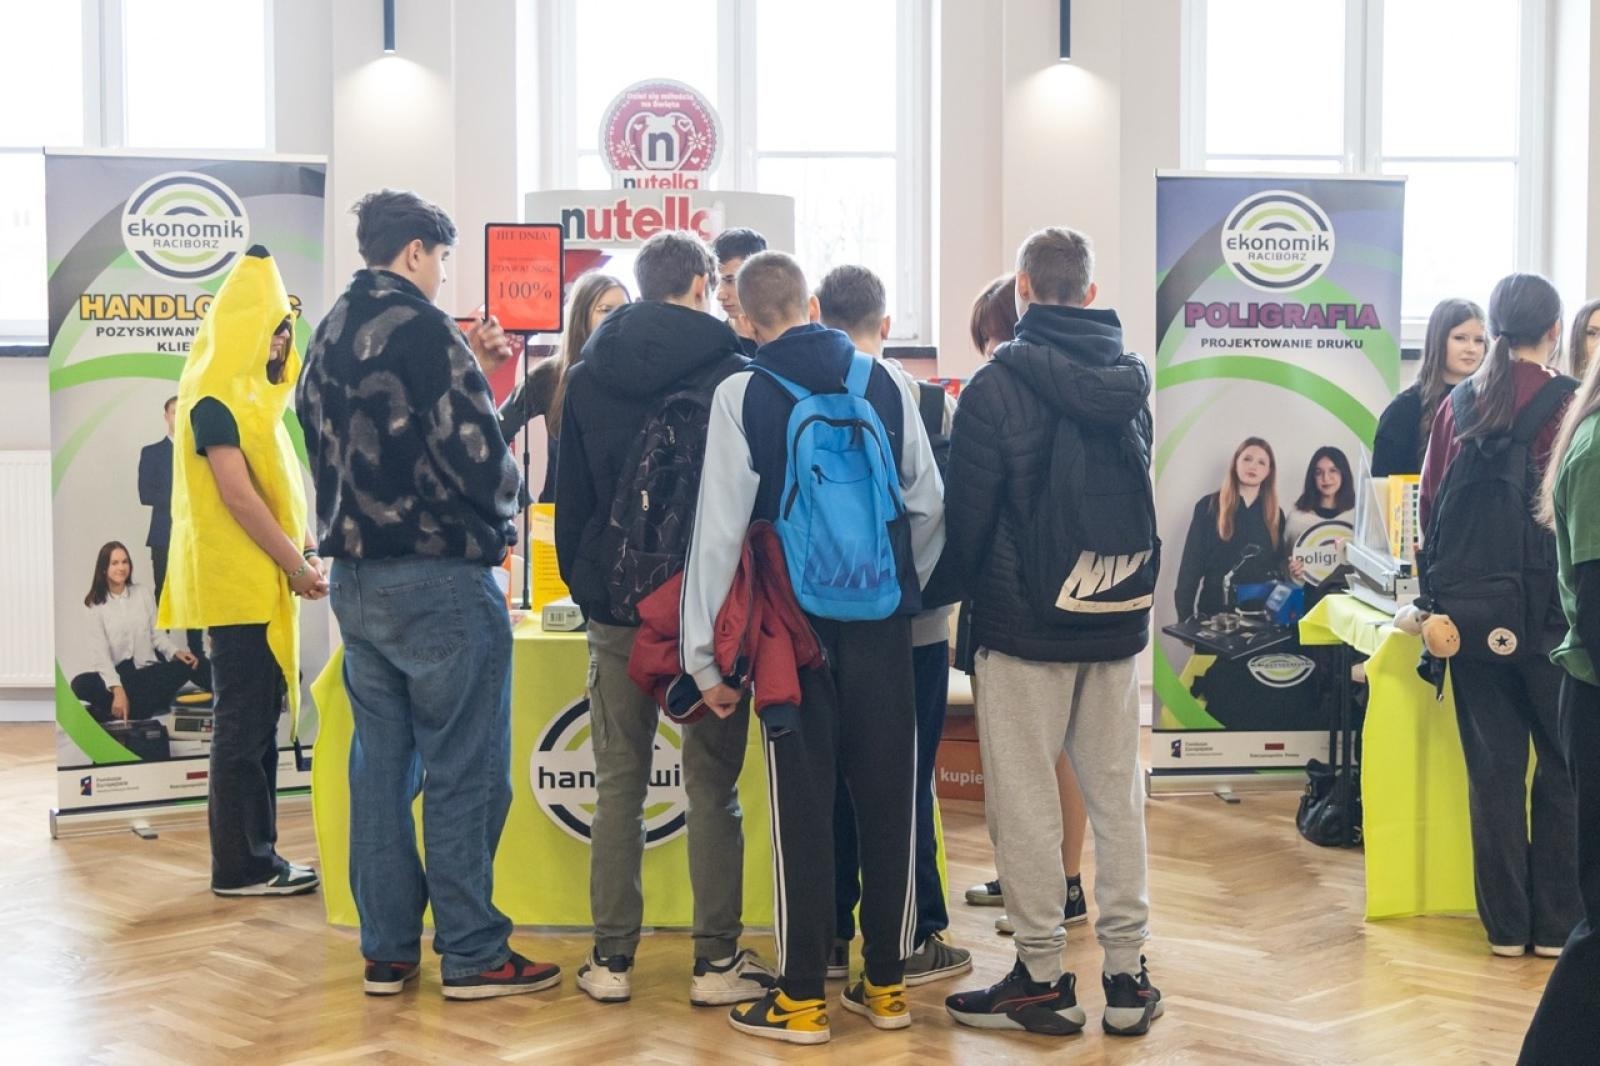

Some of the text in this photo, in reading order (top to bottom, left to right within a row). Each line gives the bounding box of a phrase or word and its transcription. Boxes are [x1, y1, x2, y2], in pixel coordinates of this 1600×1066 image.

[648, 132, 674, 162] n
[623, 173, 699, 189] nutella
[127, 218, 243, 238] ekonomik
[1226, 233, 1329, 251] ekonomik
[499, 281, 552, 300] 100%
[1184, 301, 1381, 330] POLIGRAFIA
[1201, 338, 1364, 349] PROJEKTOWANIE DRUKU
[940, 767, 984, 787] kupie
